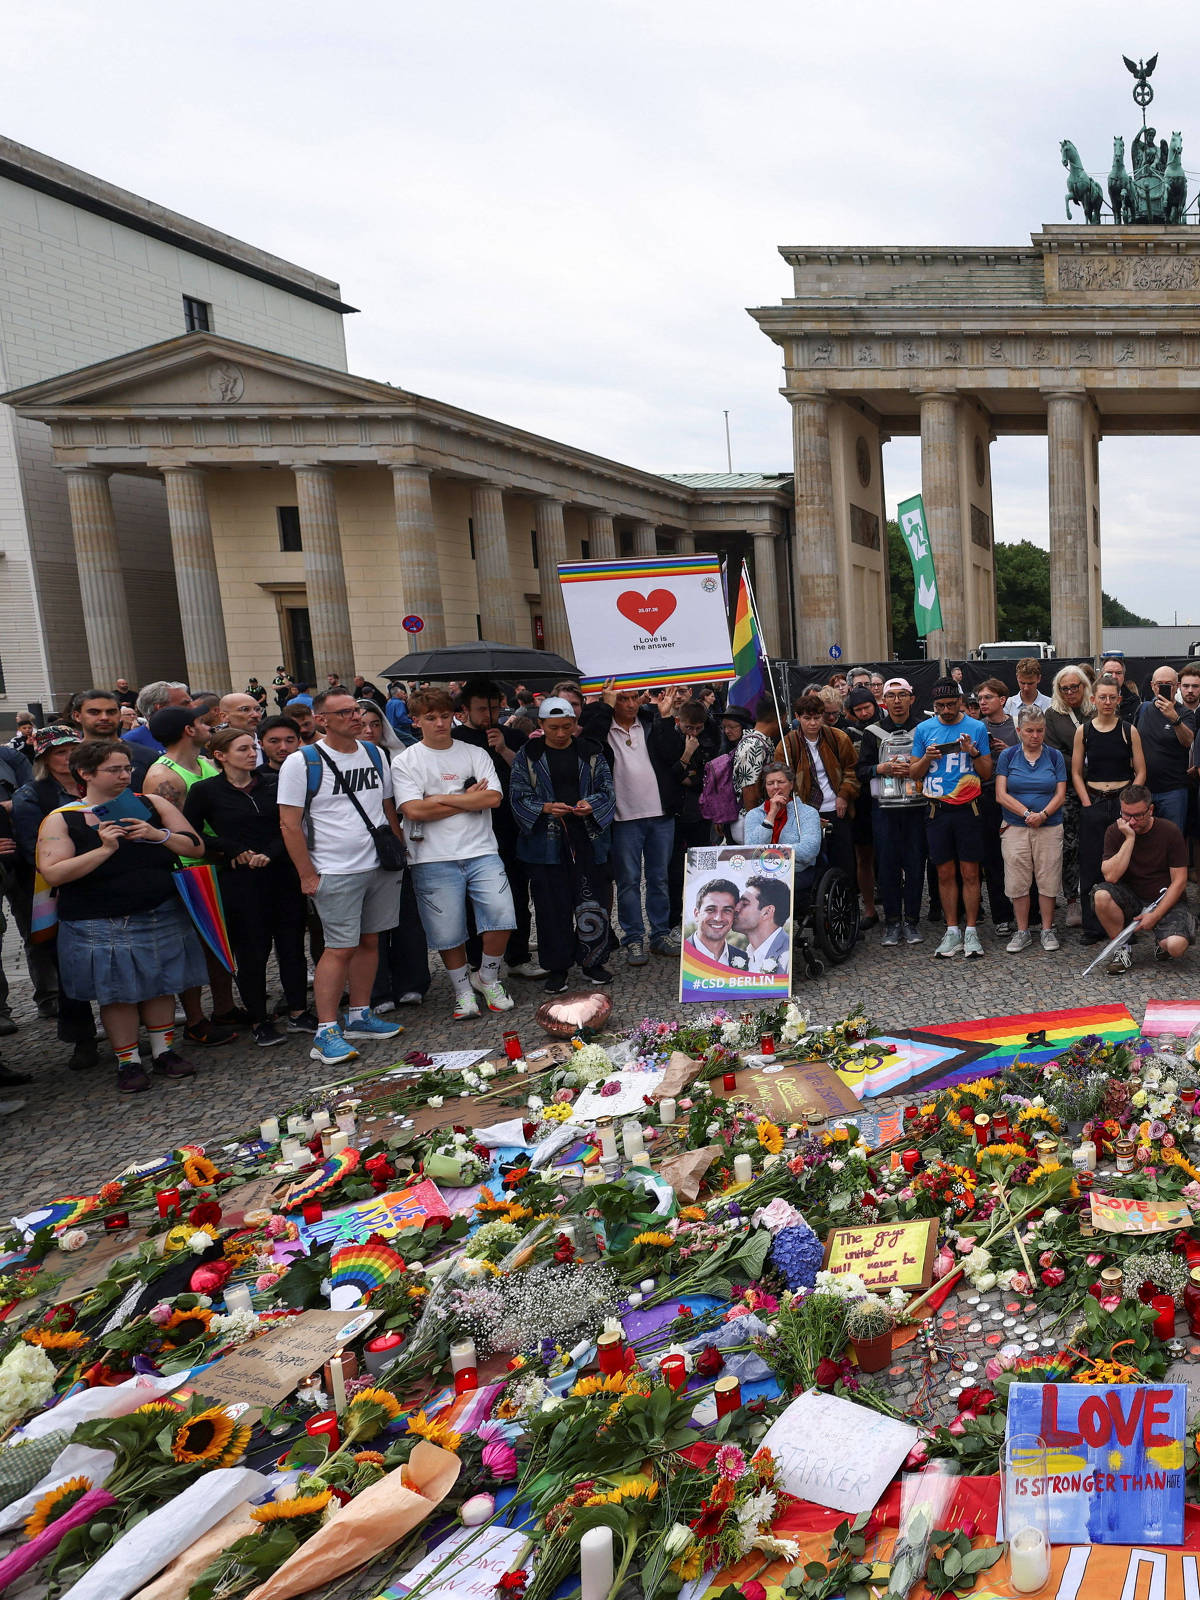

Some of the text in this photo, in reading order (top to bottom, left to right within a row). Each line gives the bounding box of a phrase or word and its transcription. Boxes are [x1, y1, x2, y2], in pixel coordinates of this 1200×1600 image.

[633, 641, 675, 651] the answer
[639, 636, 658, 644] Love
[332, 767, 379, 795] NIKE
[692, 975, 775, 990] #CSD BERLIN
[388, 1195, 428, 1222] WE
[1092, 1191, 1150, 1213] LOVE
[344, 1206, 394, 1240] ARE
[1124, 1219, 1165, 1232] ALL
[836, 1228, 906, 1248] The gays
[830, 1252, 917, 1275] will never be
[845, 1247, 880, 1260] united
[1036, 1384, 1178, 1449] LOVE
[1015, 1479, 1028, 1496] IS
[1119, 1471, 1167, 1492] THAN
[1166, 1474, 1181, 1489] HATE
